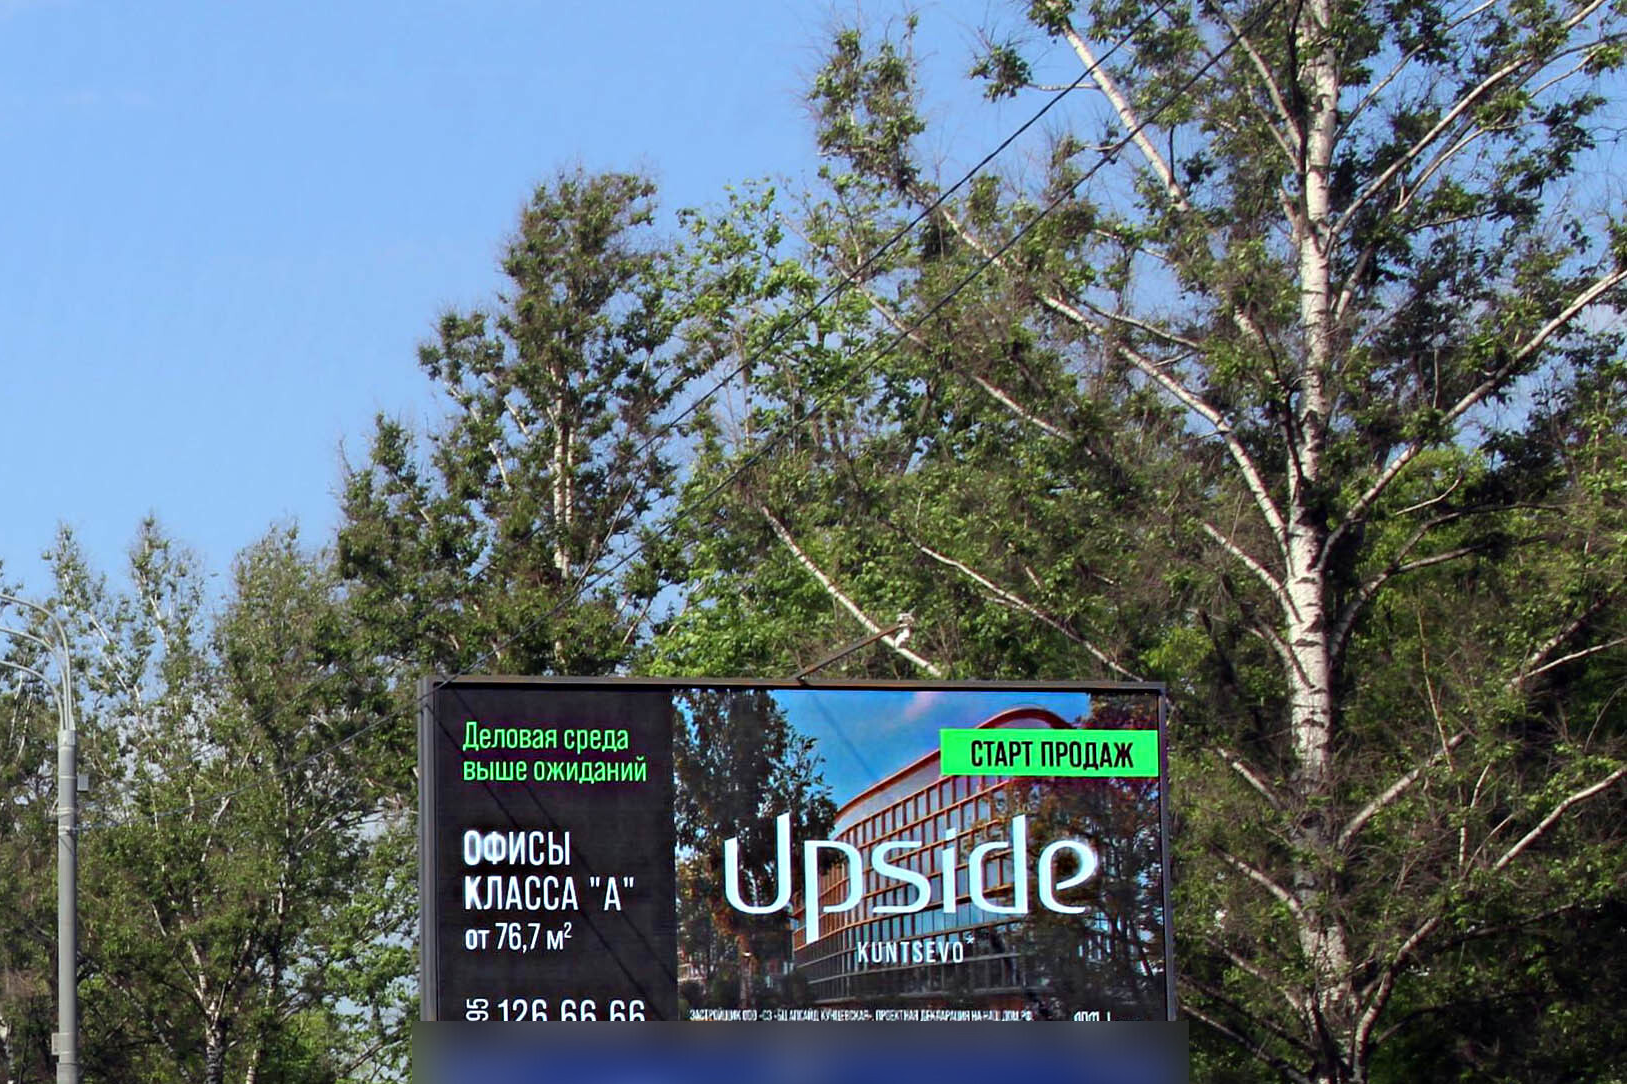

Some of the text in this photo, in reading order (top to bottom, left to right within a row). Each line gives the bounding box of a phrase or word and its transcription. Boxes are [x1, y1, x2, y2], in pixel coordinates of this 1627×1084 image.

[462, 721, 629, 755] Деловая среда
[463, 755, 648, 784] выше ожиданий
[971, 740, 1134, 771] СТАРТ ПРОДАЖ
[463, 829, 571, 866] ОФИСЫ
[464, 875, 635, 912] КЛАССА "А"
[724, 812, 1099, 945] Upside
[465, 929, 490, 951] от
[495, 922, 541, 954] 76,7
